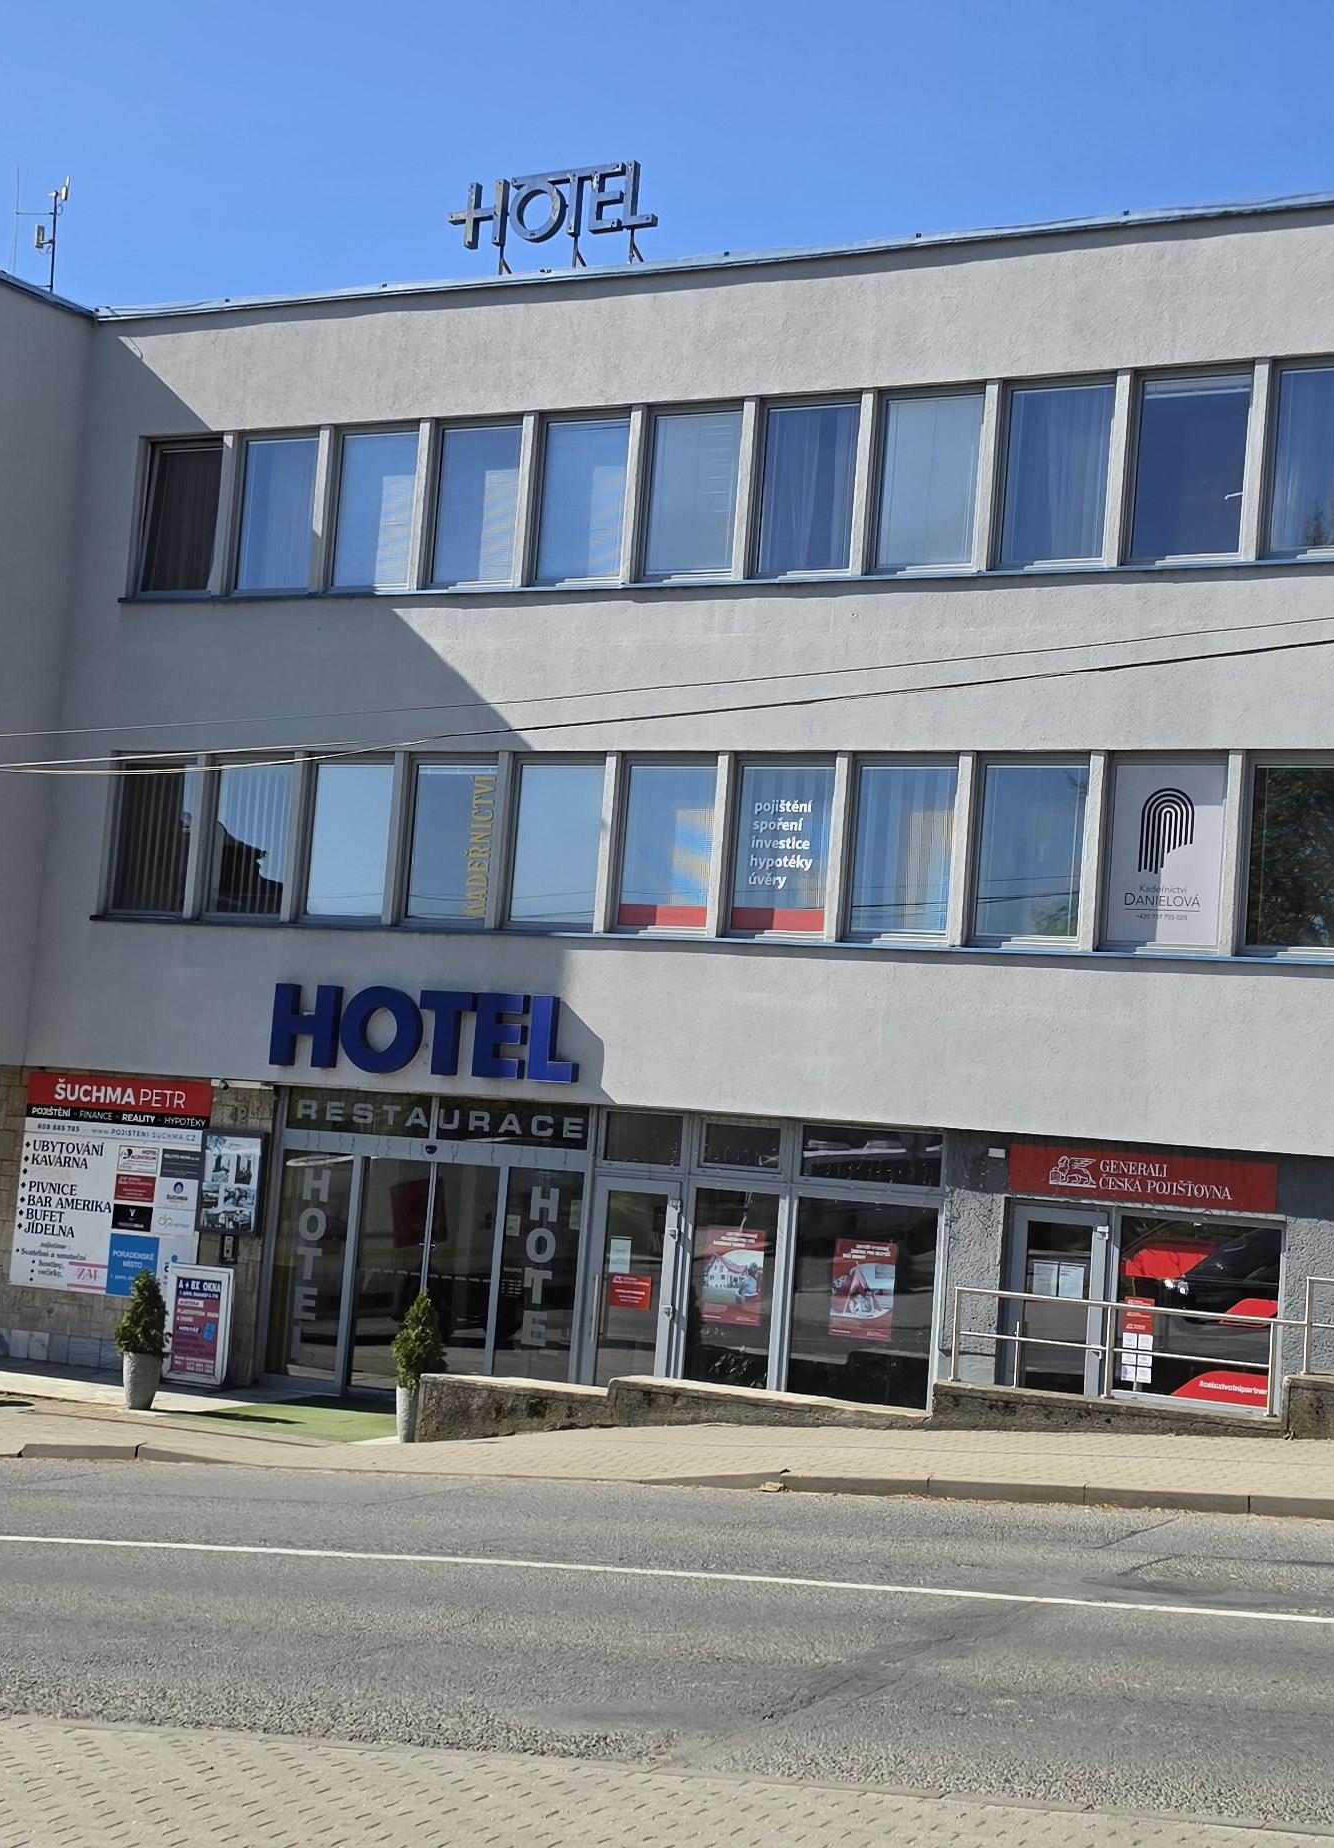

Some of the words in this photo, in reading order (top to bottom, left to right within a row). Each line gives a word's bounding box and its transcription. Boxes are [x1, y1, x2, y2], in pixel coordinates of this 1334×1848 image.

[448, 160, 658, 250] HOTEL
[754, 799, 813, 815] pojištění
[753, 817, 804, 833] spoření
[463, 775, 497, 918] KADEŘNICTVÍ
[751, 836, 811, 850] investice
[750, 854, 813, 871] hypotéky
[748, 872, 787, 890] úvěry
[1124, 892, 1200, 908] DANIELOVÁ
[269, 982, 579, 1083] HOTEL
[54, 1078, 136, 1106] ŠUCHMA
[139, 1089, 187, 1109] PETR
[79, 1110, 113, 1121] FINANCE
[121, 1113, 156, 1124] REALITY
[164, 1115, 207, 1128] HYPOTÉKY
[296, 1099, 584, 1139] RESTAURACE
[33, 1139, 105, 1157] UBYTOVÁNÍ
[31, 1153, 89, 1169] KAVÁRNA
[1100, 1159, 1167, 1177] GENERALI
[28, 1180, 78, 1196] PIVNICE
[1099, 1173, 1142, 1193] ČESKÁ
[1147, 1179, 1233, 1201] POJIŠŤOVNA
[27, 1194, 52, 1208] BAR
[55, 1197, 112, 1213] AMERIKA
[25, 1208, 65, 1223] BUFET
[24, 1219, 75, 1238] JÍDELNA
[521, 1186, 559, 1348] HOTE
